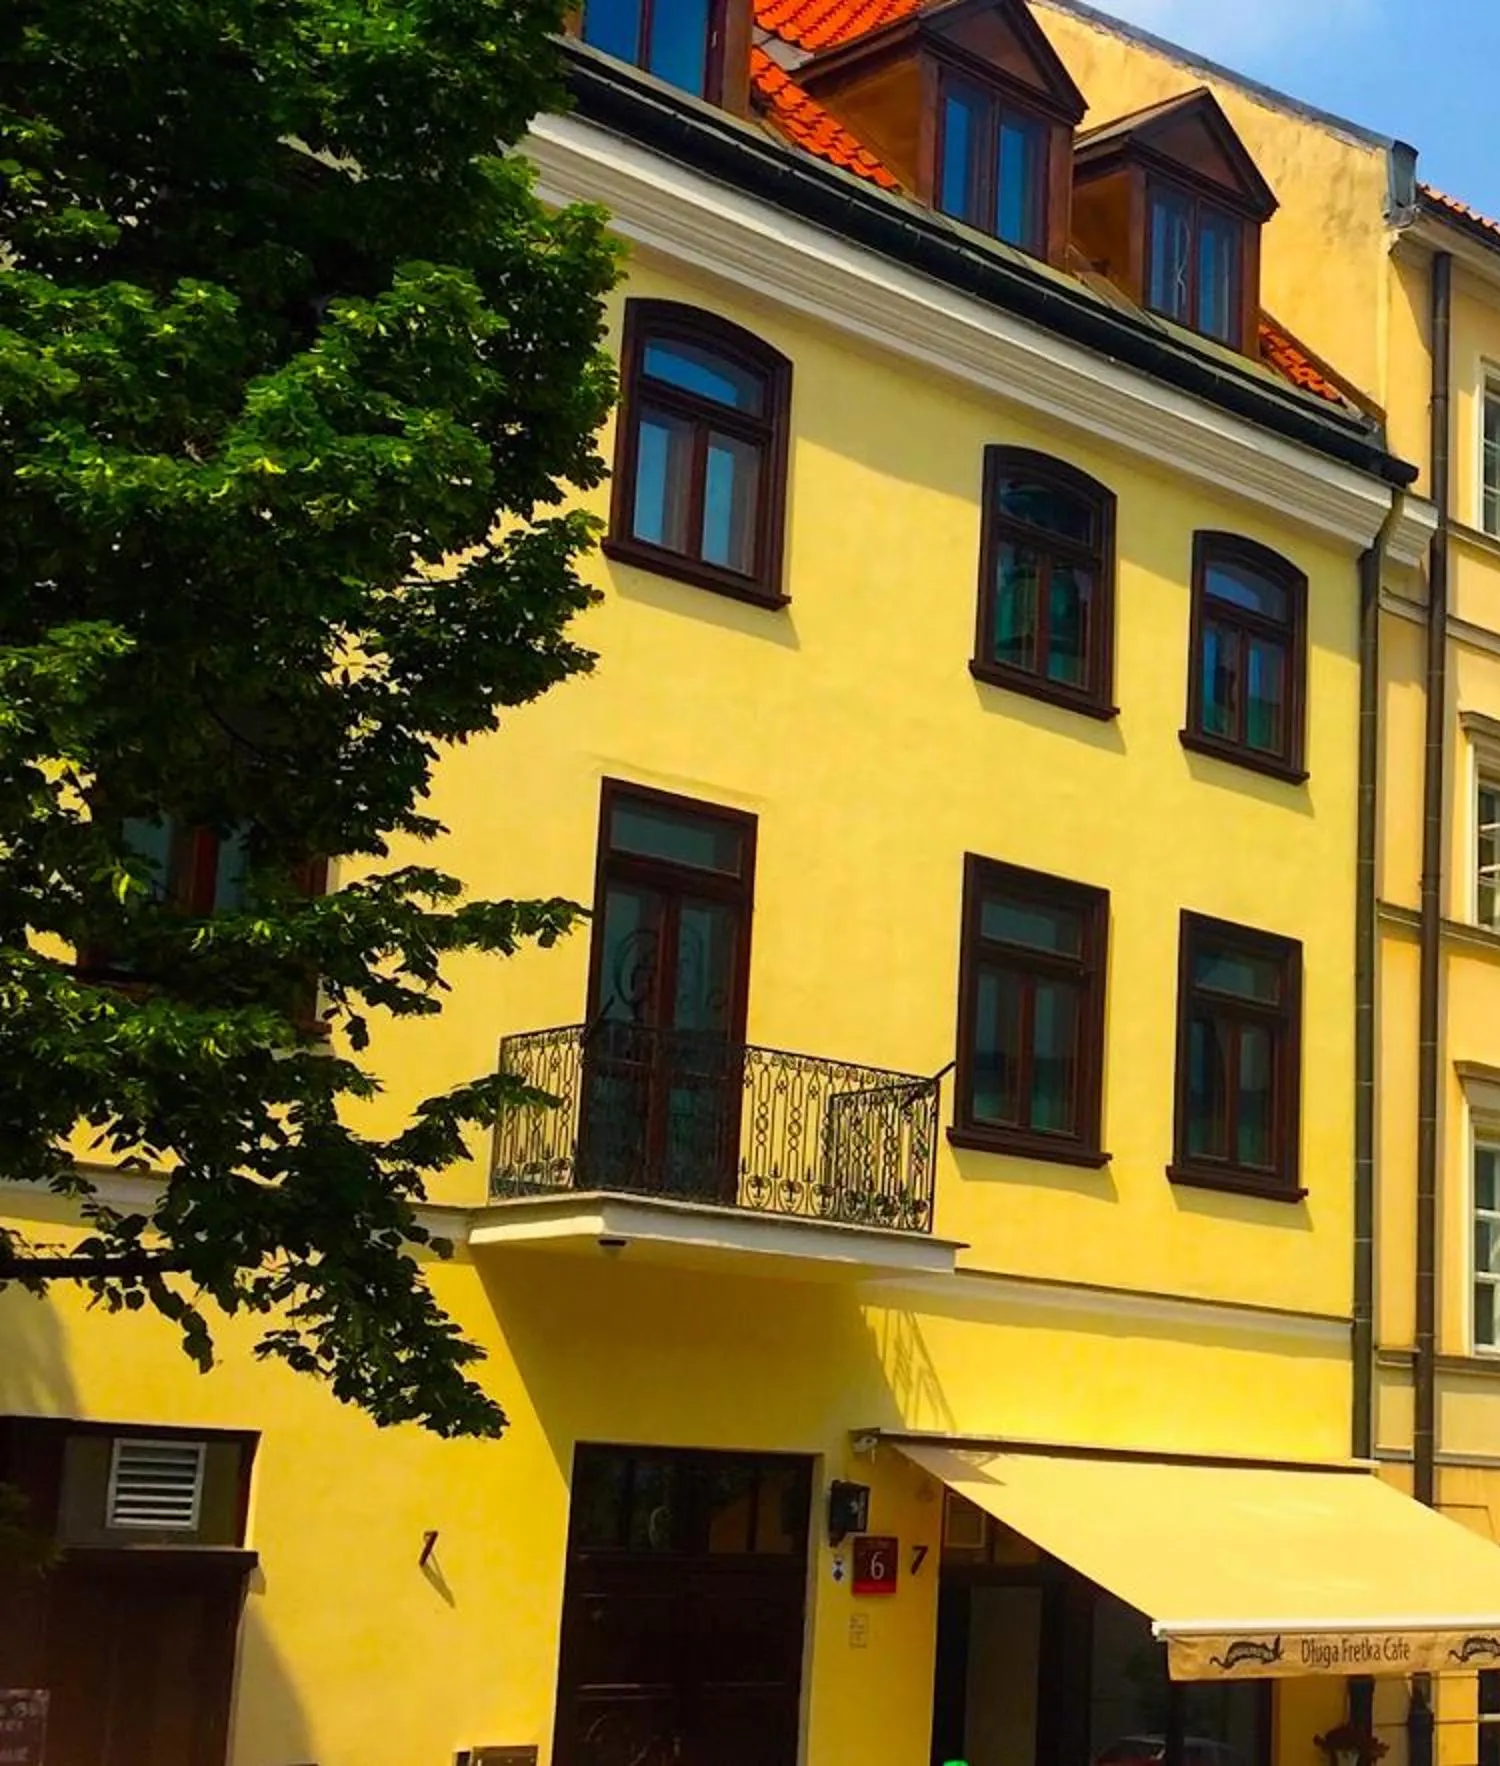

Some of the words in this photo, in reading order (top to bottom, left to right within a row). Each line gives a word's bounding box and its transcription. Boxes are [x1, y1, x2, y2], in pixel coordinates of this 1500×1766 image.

[871, 1551, 885, 1580] 6
[1301, 1638, 1339, 1669] Długa
[1341, 1637, 1381, 1662] Fretka
[1383, 1636, 1410, 1661] Cafe
